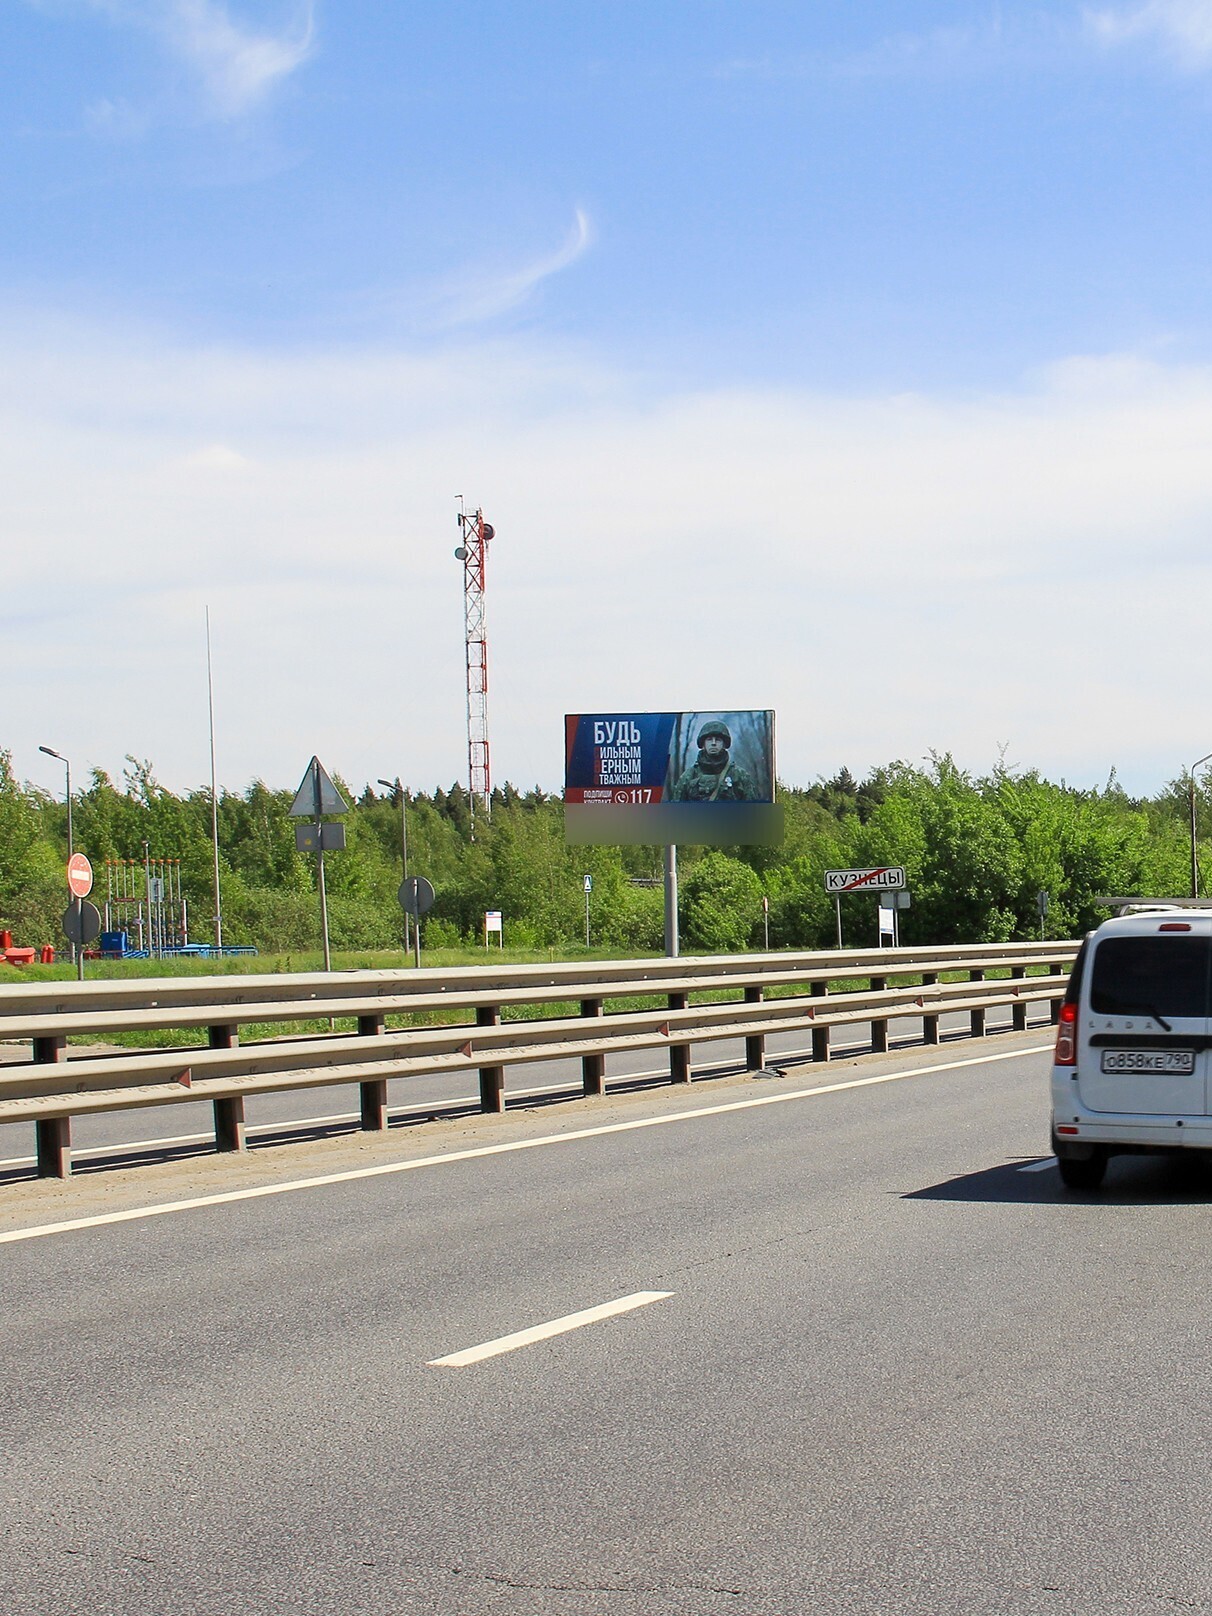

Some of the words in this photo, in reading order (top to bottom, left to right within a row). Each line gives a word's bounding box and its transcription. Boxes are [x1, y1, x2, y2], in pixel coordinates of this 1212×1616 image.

[594, 721, 641, 746] БУДЬ
[630, 789, 652, 803] 117
[1089, 1021, 1153, 1029] LADA
